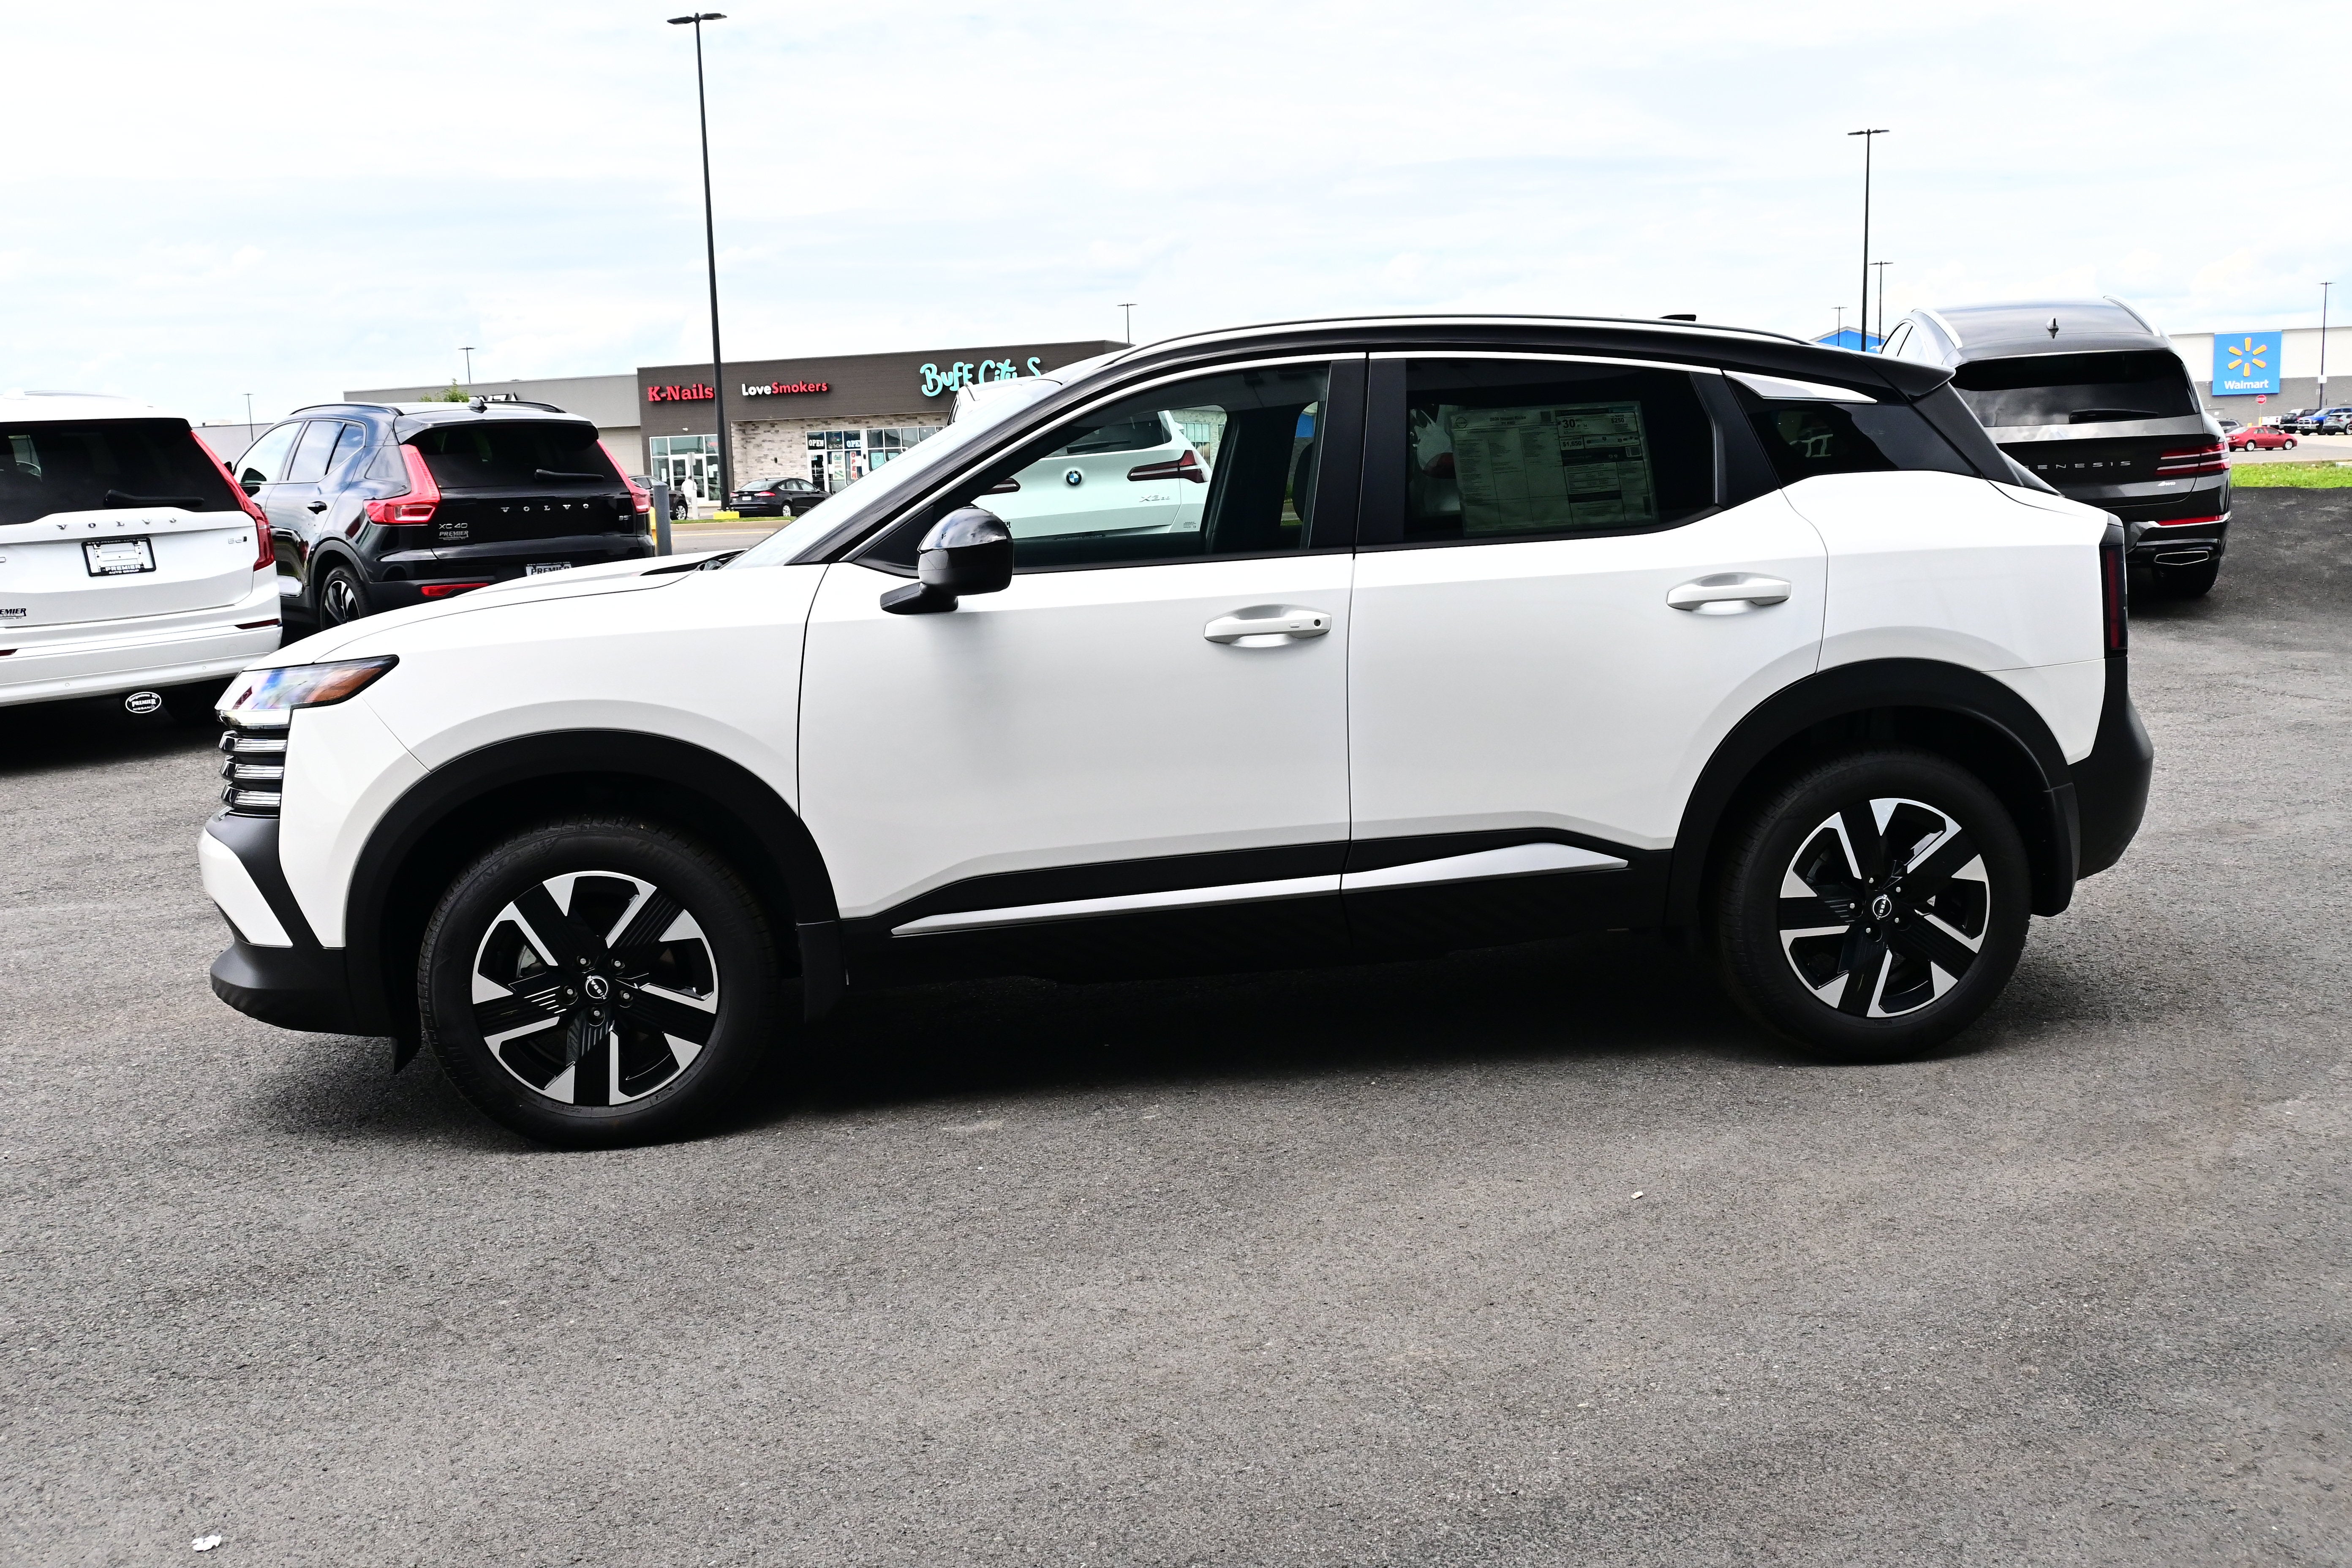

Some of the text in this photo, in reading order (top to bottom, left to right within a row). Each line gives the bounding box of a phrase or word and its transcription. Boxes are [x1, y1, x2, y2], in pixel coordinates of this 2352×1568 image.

[2224, 379, 2269, 389] Walmart
[648, 384, 715, 401] K-Nails
[1563, 419, 1576, 428] 30
[501, 503, 589, 513] VOLVO
[131, 699, 156, 707] PREMIER
[1876, 894, 1888, 920] NISSAN
[587, 975, 607, 1000] NISSAN
